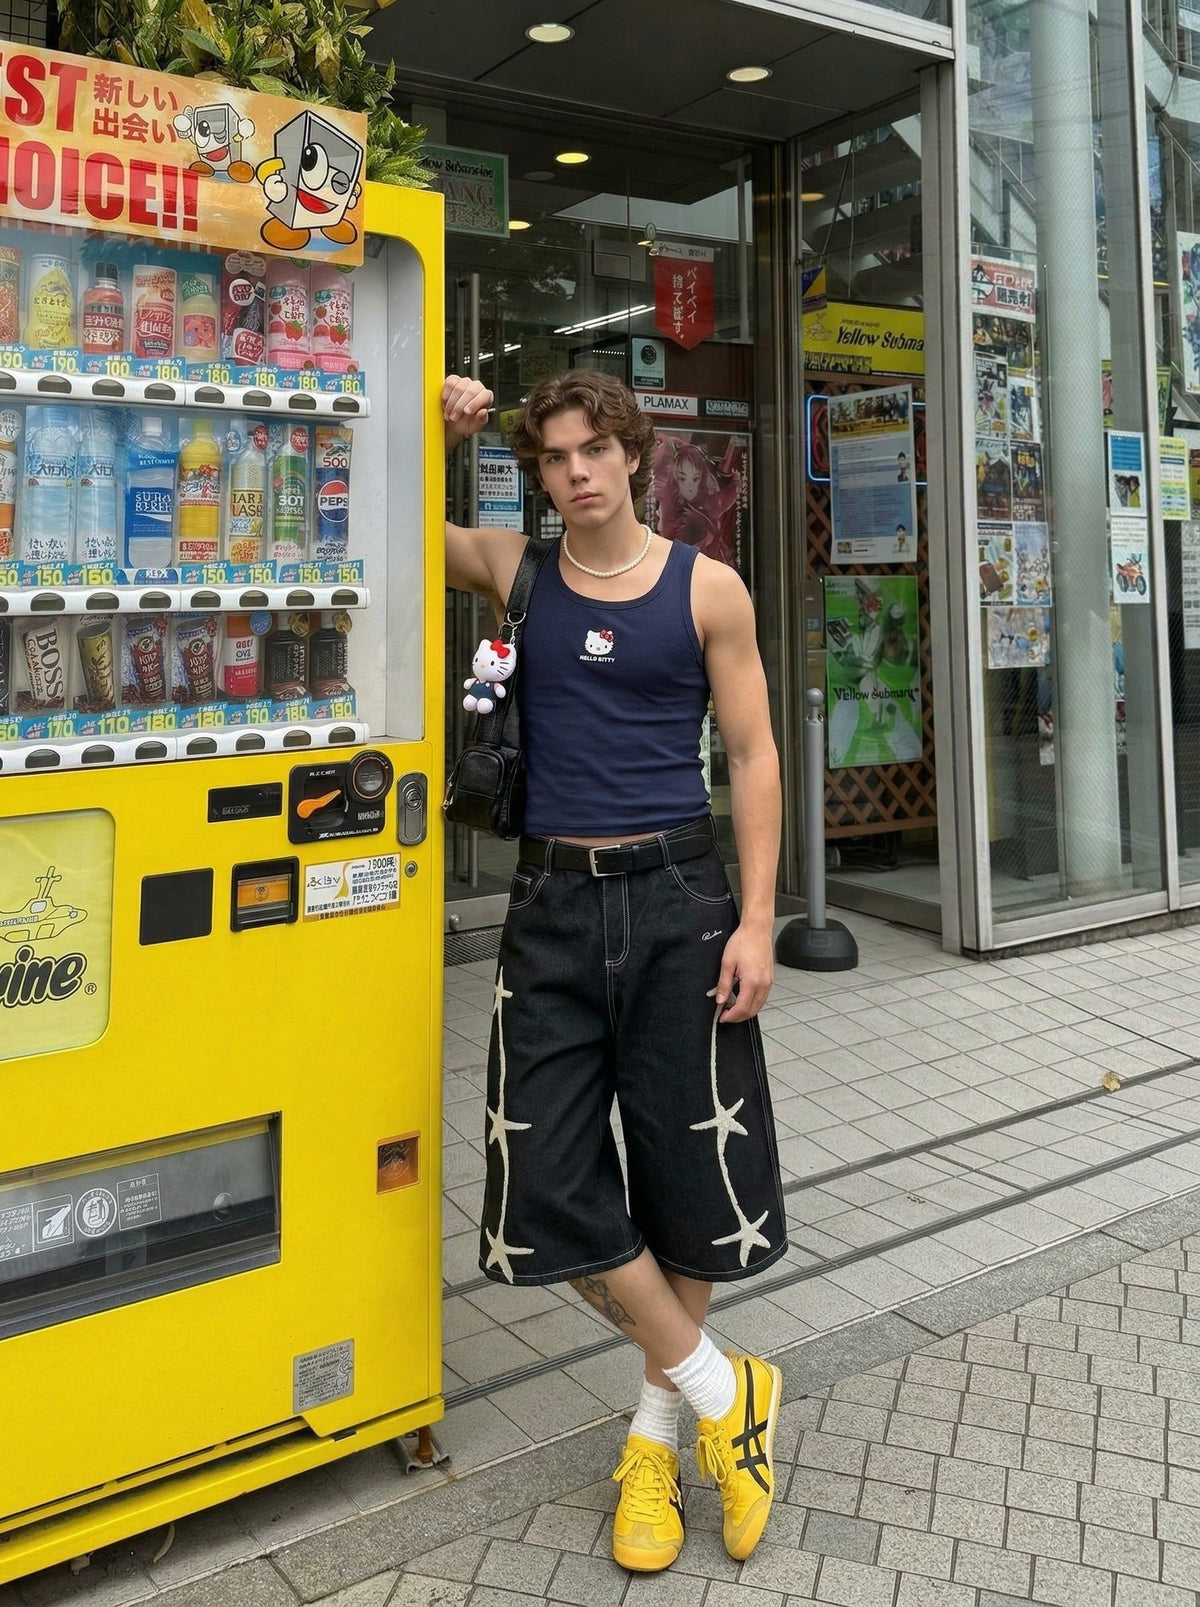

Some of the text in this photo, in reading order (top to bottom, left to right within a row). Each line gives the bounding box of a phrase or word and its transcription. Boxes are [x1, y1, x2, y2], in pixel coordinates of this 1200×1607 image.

[0, 53, 88, 133] ST
[93, 73, 179, 111] 新しい
[92, 107, 177, 144] 出会い
[0, 136, 199, 232] OICE!!
[836, 325, 881, 347] Yellow
[51, 356, 77, 372] 190
[106, 360, 131, 377] 100
[155, 364, 180, 380] 180
[206, 368, 231, 385] 180
[254, 373, 277, 388] 180
[298, 376, 319, 391] 180
[339, 380, 361, 394] 180
[643, 396, 689, 410] PLAMAX
[322, 456, 348, 468] 500
[35, 569, 64, 586] 150
[201, 569, 227, 584] 150
[248, 569, 273, 584] 150
[298, 569, 322, 584] 150
[337, 569, 359, 584] 150
[35, 627, 64, 699] BOSS
